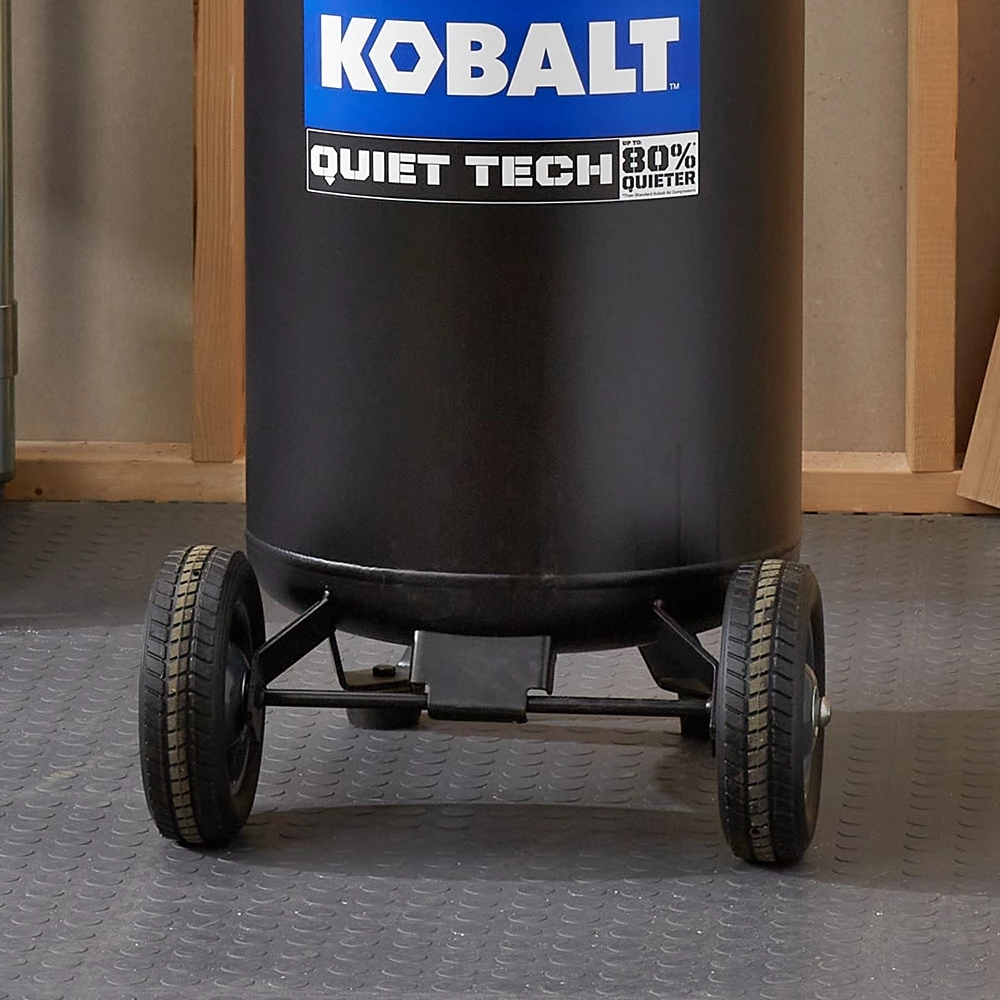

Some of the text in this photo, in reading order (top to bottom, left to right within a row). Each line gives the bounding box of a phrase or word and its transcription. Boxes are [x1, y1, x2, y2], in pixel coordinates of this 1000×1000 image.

[320, 13, 680, 97] KOBALT
[310, 144, 613, 187] QUIET TECH
[622, 171, 695, 192] QUIETER
